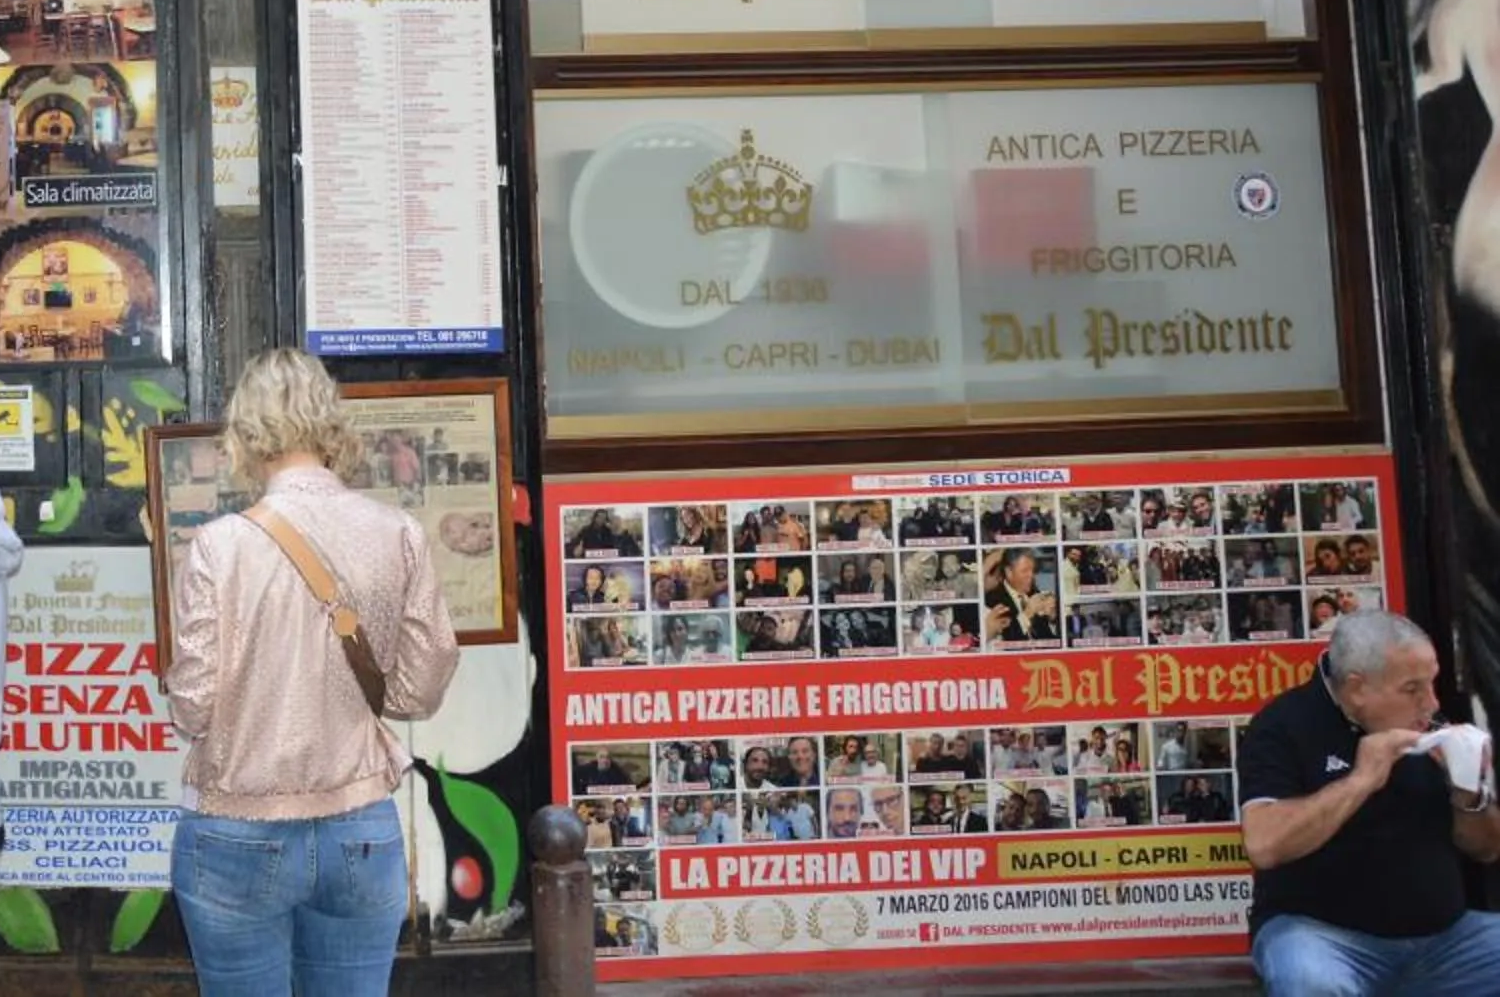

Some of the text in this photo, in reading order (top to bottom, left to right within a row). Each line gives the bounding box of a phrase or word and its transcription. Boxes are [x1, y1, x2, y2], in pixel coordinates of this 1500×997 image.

[986, 127, 1261, 163] ANTICA PIZZERIA
[25, 177, 153, 204] Sala climatizzata
[1117, 188, 1138, 216] E
[1030, 244, 1237, 276] FRIGGITORIA
[680, 278, 742, 307] DAL
[722, 341, 819, 370] CAPRI
[846, 337, 941, 368] DUBAI
[980, 309, 1296, 370] Dal Presidente
[928, 474, 977, 487] SEDE
[983, 469, 1066, 485] STORICA
[4, 642, 160, 677] PIZZA
[2, 685, 154, 716] SENZA
[565, 690, 673, 727] ANTICA
[676, 685, 800, 722] PIZZERIA
[806, 685, 822, 718] E
[827, 677, 1008, 718] FRIGGITORIA
[1020, 656, 1118, 714] Dal
[19, 759, 137, 780] IMPASTO
[11, 825, 150, 838] CON ATTESTATO
[61, 808, 181, 825] AUTORIZZATA
[35, 855, 128, 869] CELIACI
[669, 856, 712, 891] LA
[717, 851, 862, 889] PIZZERIA
[868, 848, 923, 884] DEI
[928, 847, 987, 881] VIP
[1010, 850, 1098, 871] NAPOLI
[1117, 846, 1189, 866] CAPRI
[876, 880, 1252, 916] 7 MARZO 2016 CAMPIONI DEL MONDO LAS VEG
[943, 925, 965, 938] DAL
[968, 922, 1041, 937] PRESIDENTE
[1041, 912, 1240, 934] www.dalpresidentepizzeria.it
